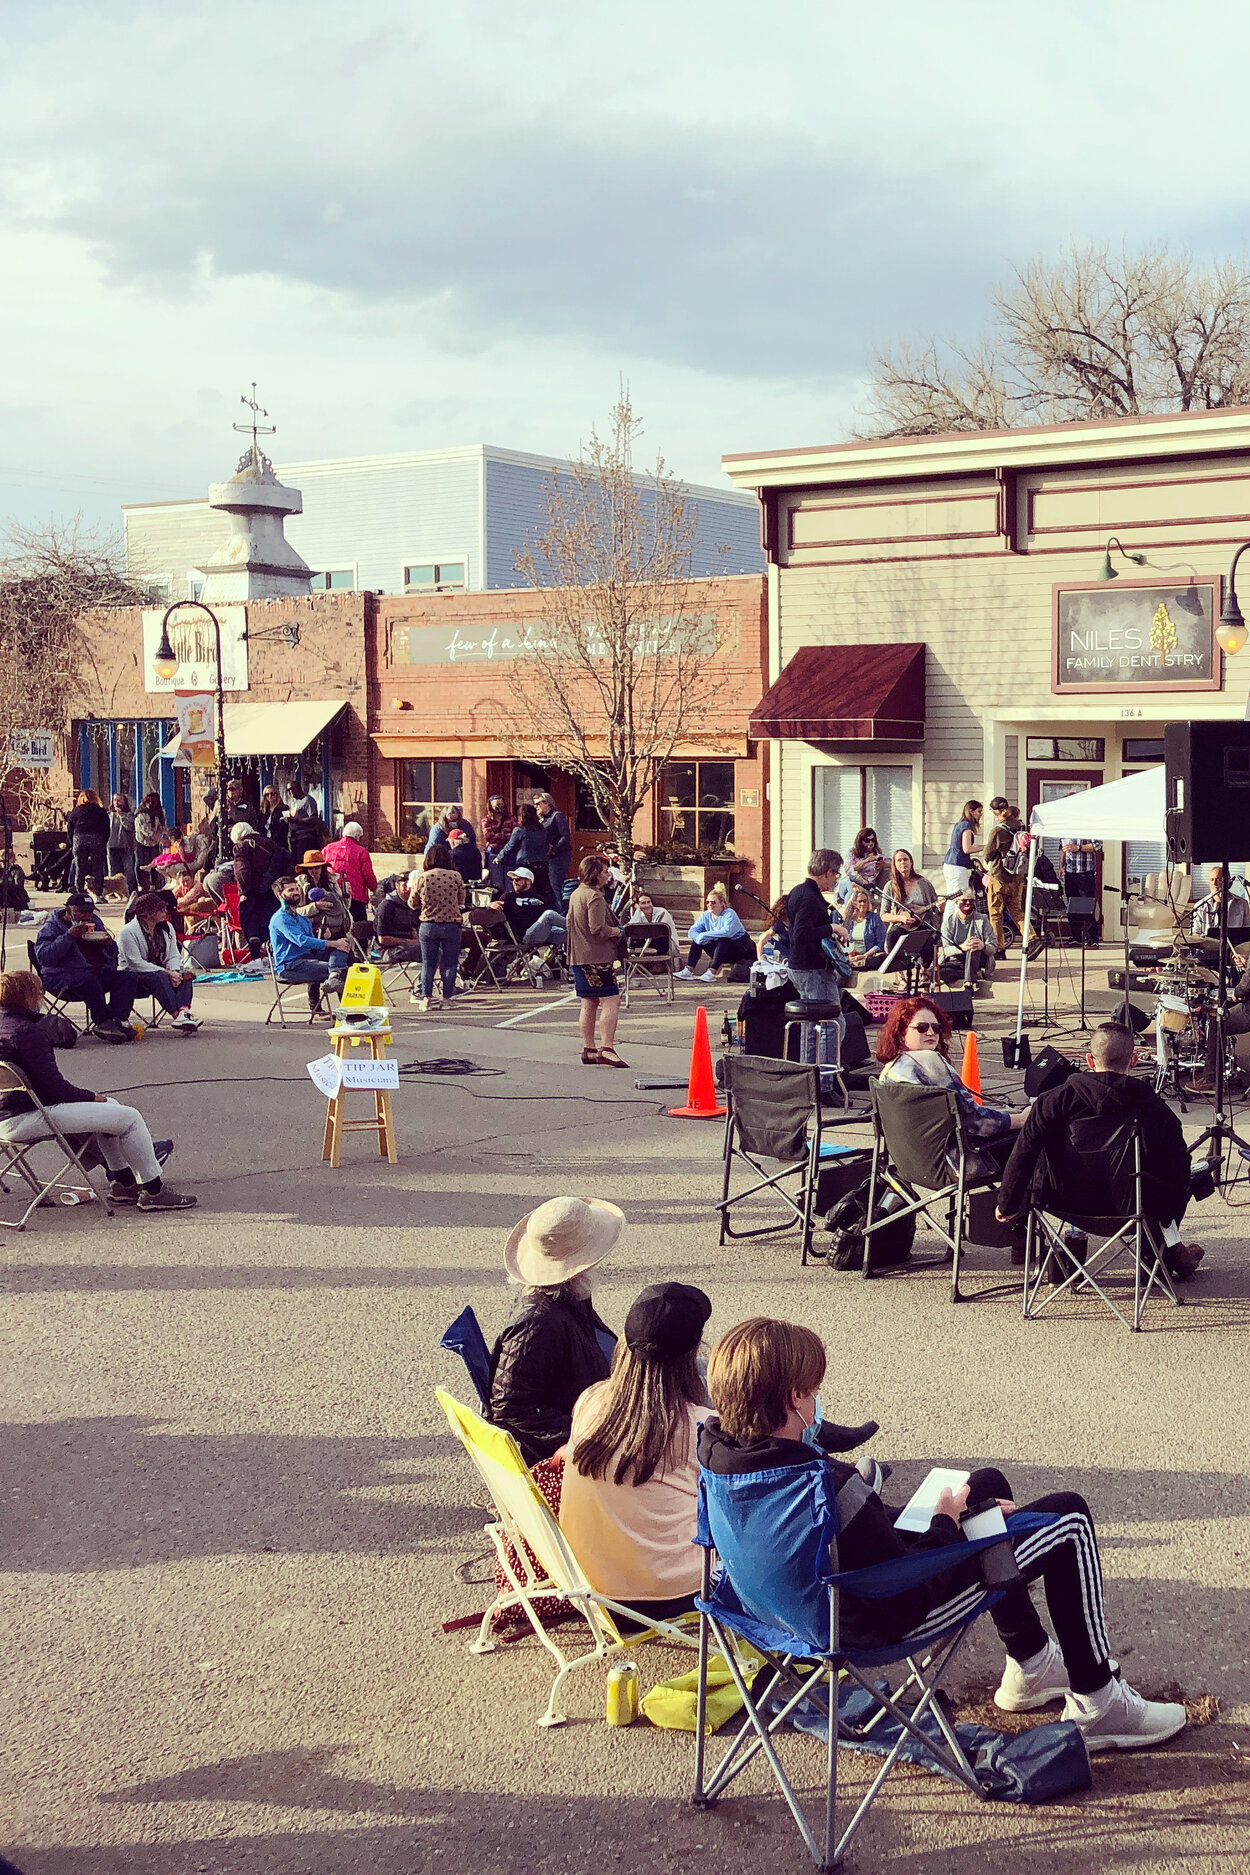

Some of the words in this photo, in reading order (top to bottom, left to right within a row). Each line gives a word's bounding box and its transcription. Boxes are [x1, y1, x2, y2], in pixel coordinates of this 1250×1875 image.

[445, 629, 477, 661] few
[481, 628, 499, 659] of
[502, 638, 514, 648] a
[1070, 628, 1143, 651] NILES
[1066, 656, 1116, 669] FAMILY
[209, 673, 236, 687] Gaery
[1121, 709, 1135, 717] 136
[1137, 709, 1143, 717] A
[344, 1063, 366, 1071] TIP
[370, 1063, 395, 1071] JAR
[345, 1076, 397, 1084] Musicians
